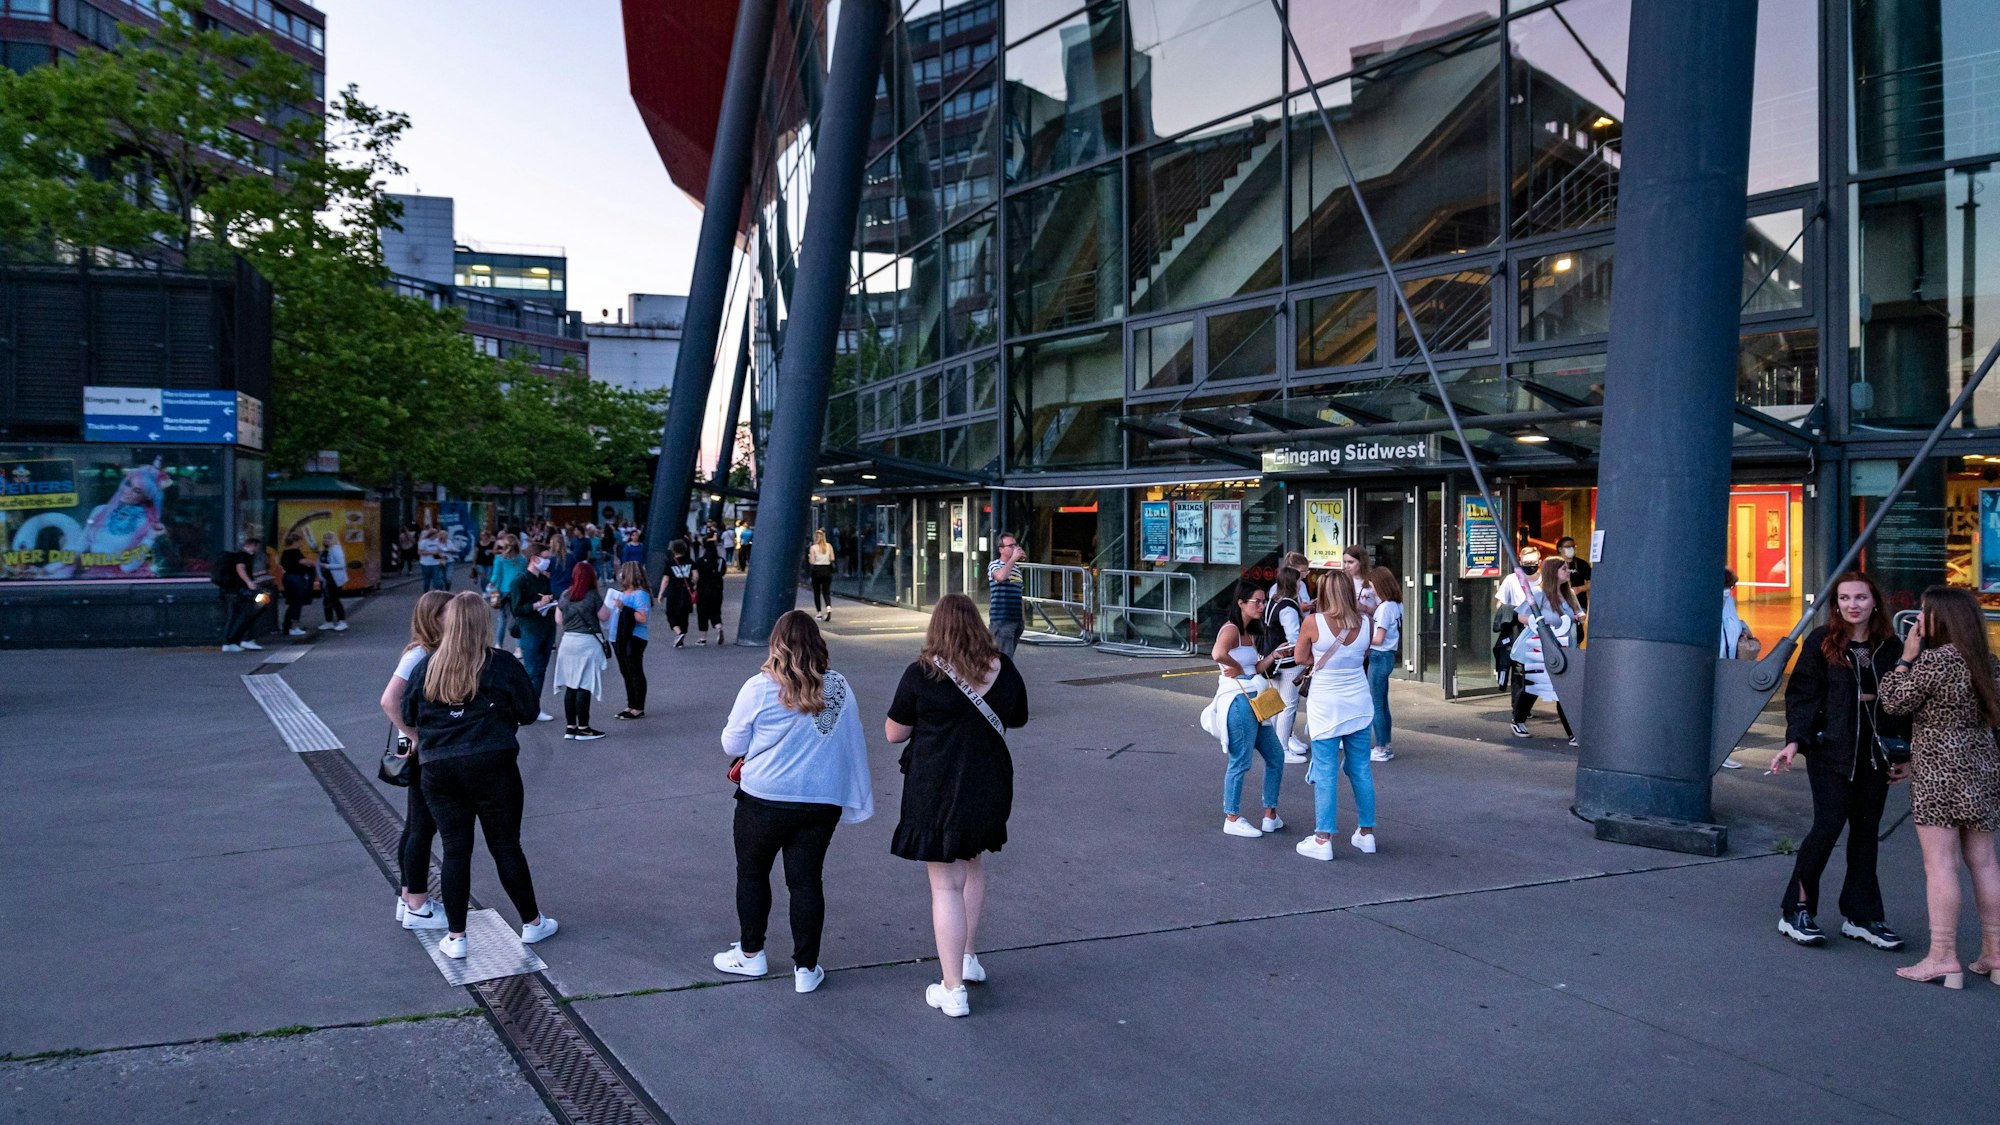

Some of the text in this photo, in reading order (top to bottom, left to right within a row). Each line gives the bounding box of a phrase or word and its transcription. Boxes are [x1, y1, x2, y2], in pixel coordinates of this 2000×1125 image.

[1274, 441, 1426, 466] Eingang Südwest
[1310, 501, 1341, 515] OTTO
[1316, 513, 1335, 523] LIVE!
[3, 549, 44, 565] WER
[49, 549, 75, 564] DU
